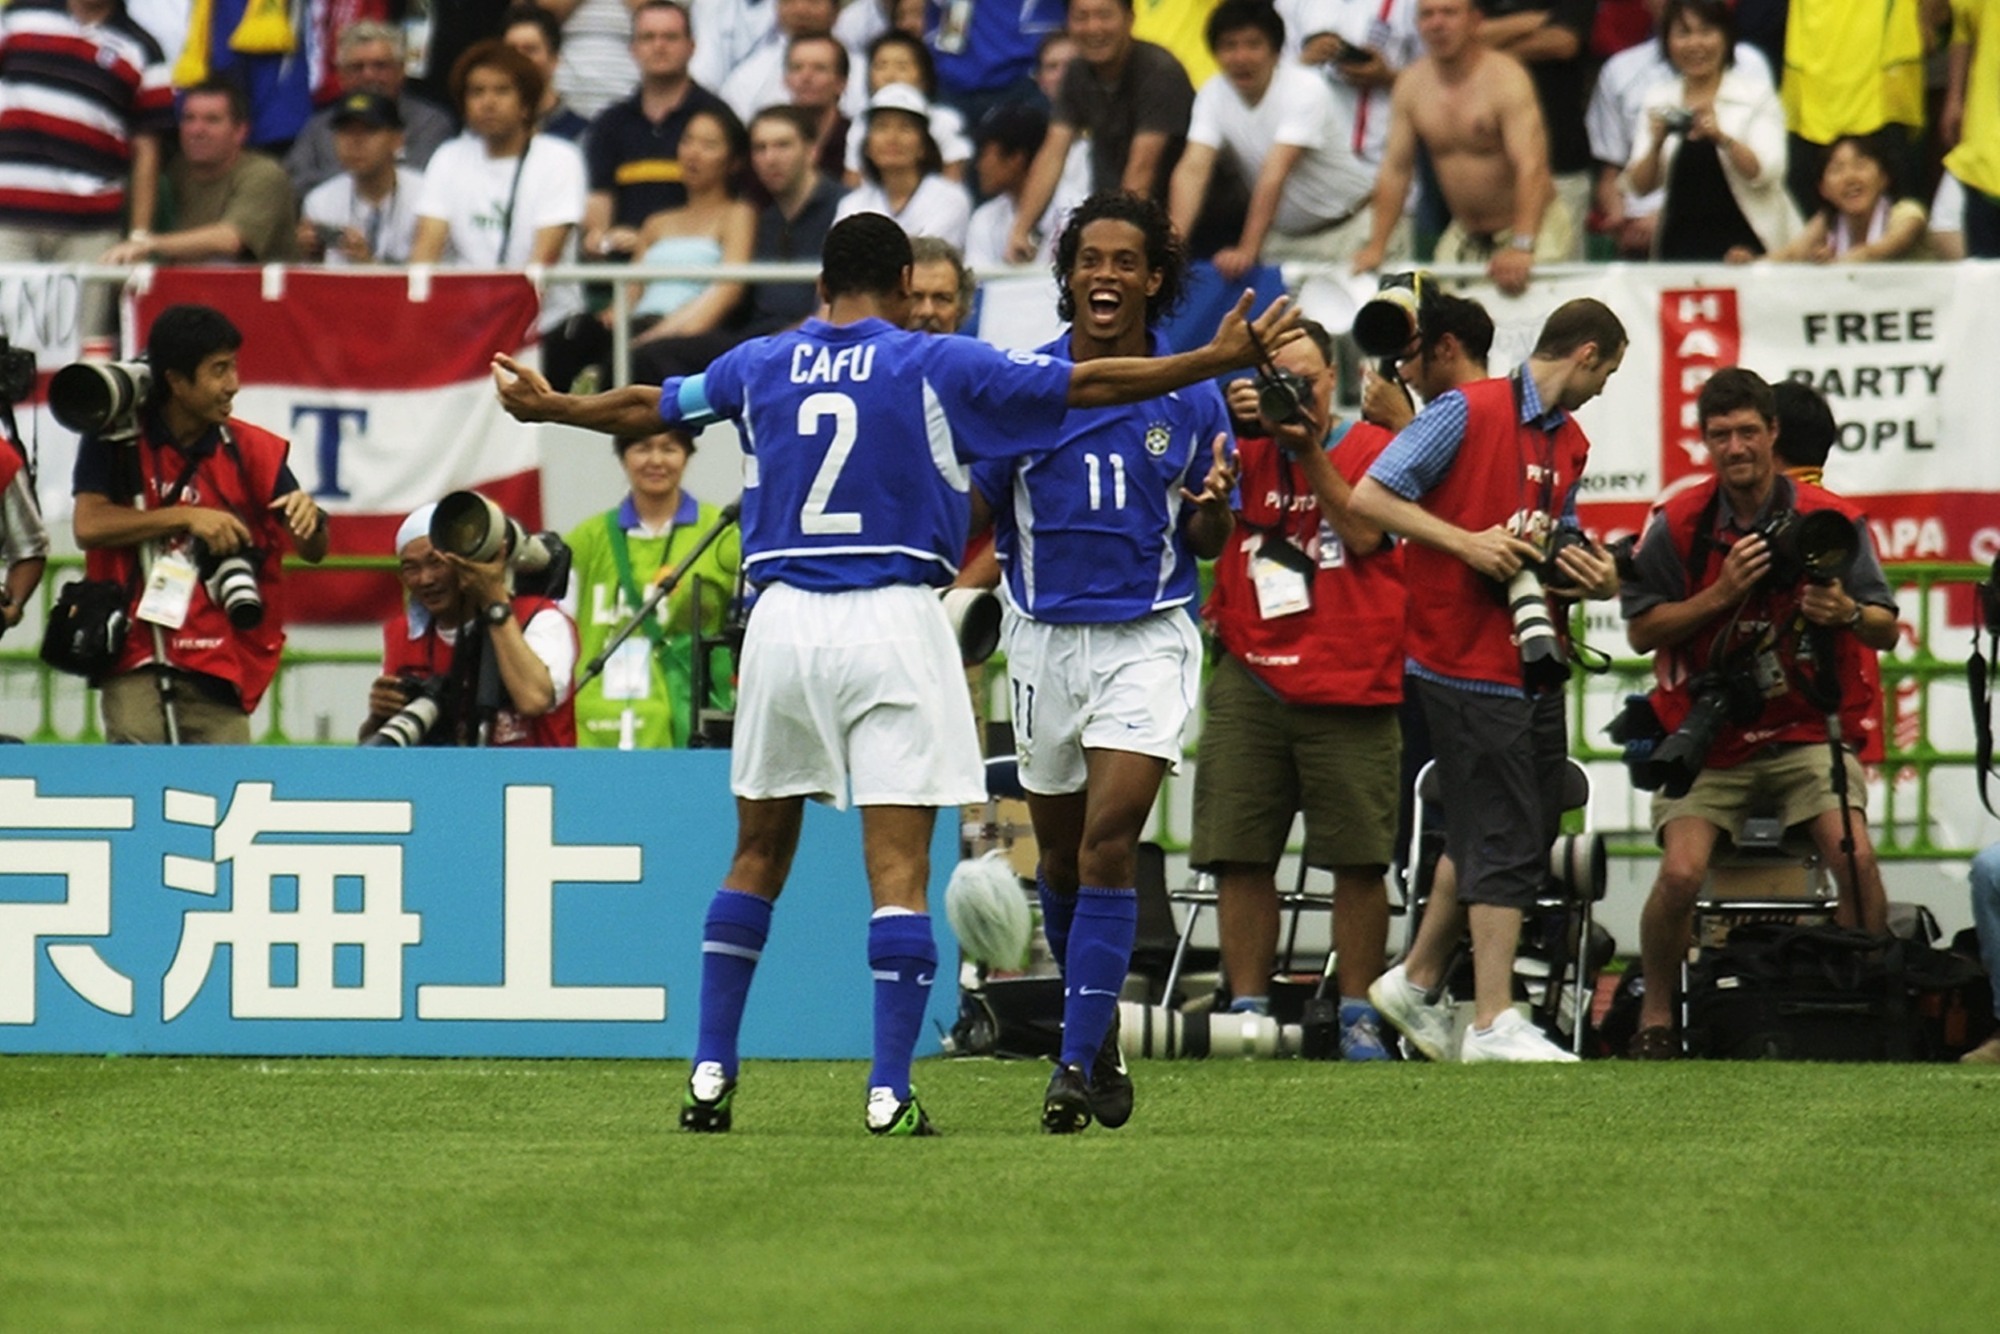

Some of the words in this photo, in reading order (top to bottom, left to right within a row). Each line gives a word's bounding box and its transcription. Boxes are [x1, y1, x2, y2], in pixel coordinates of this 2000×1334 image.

[0, 273, 80, 349] ND
[1803, 309, 1934, 345] FREE
[790, 343, 875, 384] CAFU
[1787, 364, 1945, 398] PARTY
[290, 406, 368, 498] T
[798, 392, 862, 535] 2
[1084, 453, 1126, 510] 11
[1012, 678, 1034, 739] 11
[0, 777, 667, 1024] 京海上
